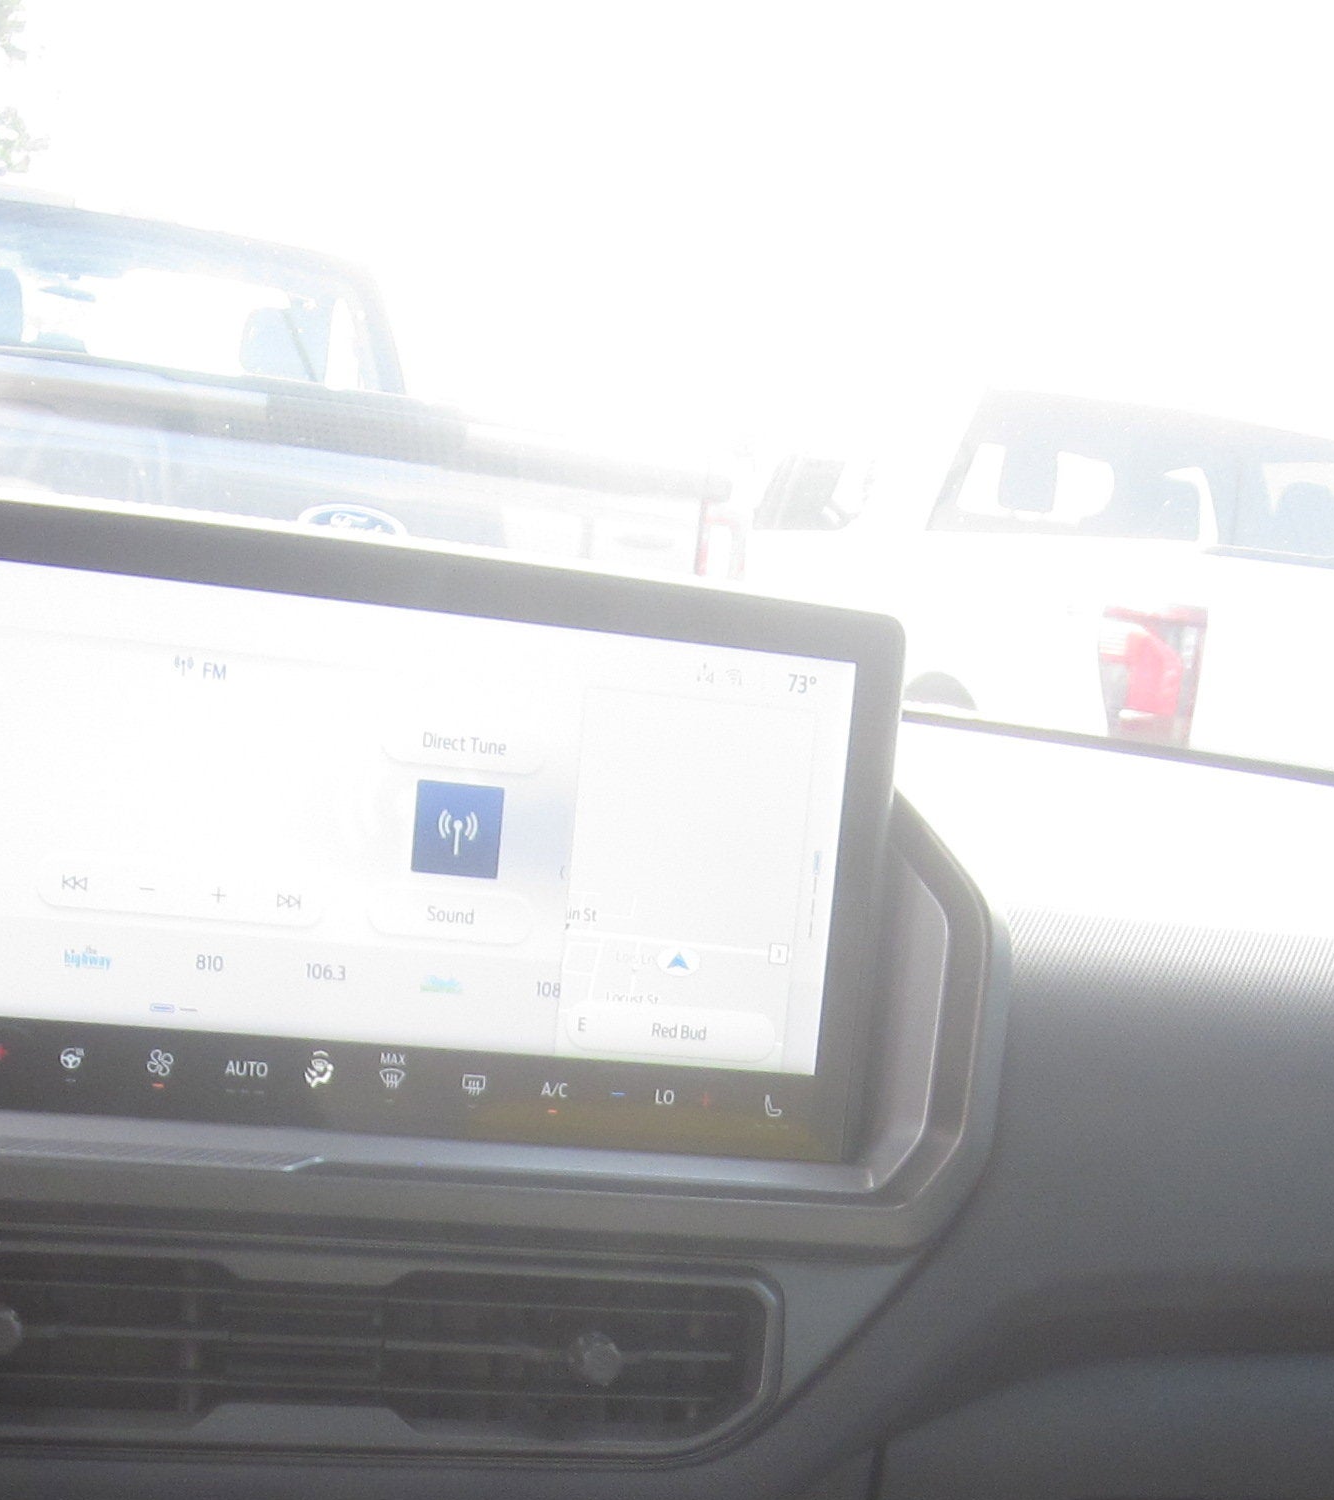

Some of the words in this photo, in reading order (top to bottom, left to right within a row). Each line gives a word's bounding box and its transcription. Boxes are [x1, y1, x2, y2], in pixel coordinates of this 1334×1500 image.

[202, 662, 227, 681] FM
[422, 732, 466, 754] Direct
[470, 736, 507, 757] Tune
[427, 905, 475, 926] Sound
[195, 953, 224, 973] 810
[305, 963, 347, 982] 106.3
[652, 1023, 677, 1039] Red
[680, 1025, 707, 1042] Bud
[225, 1060, 268, 1078] AUTO
[380, 1053, 406, 1066] MAX
[541, 1082, 567, 1098] A/C
[655, 1089, 675, 1106] LO
